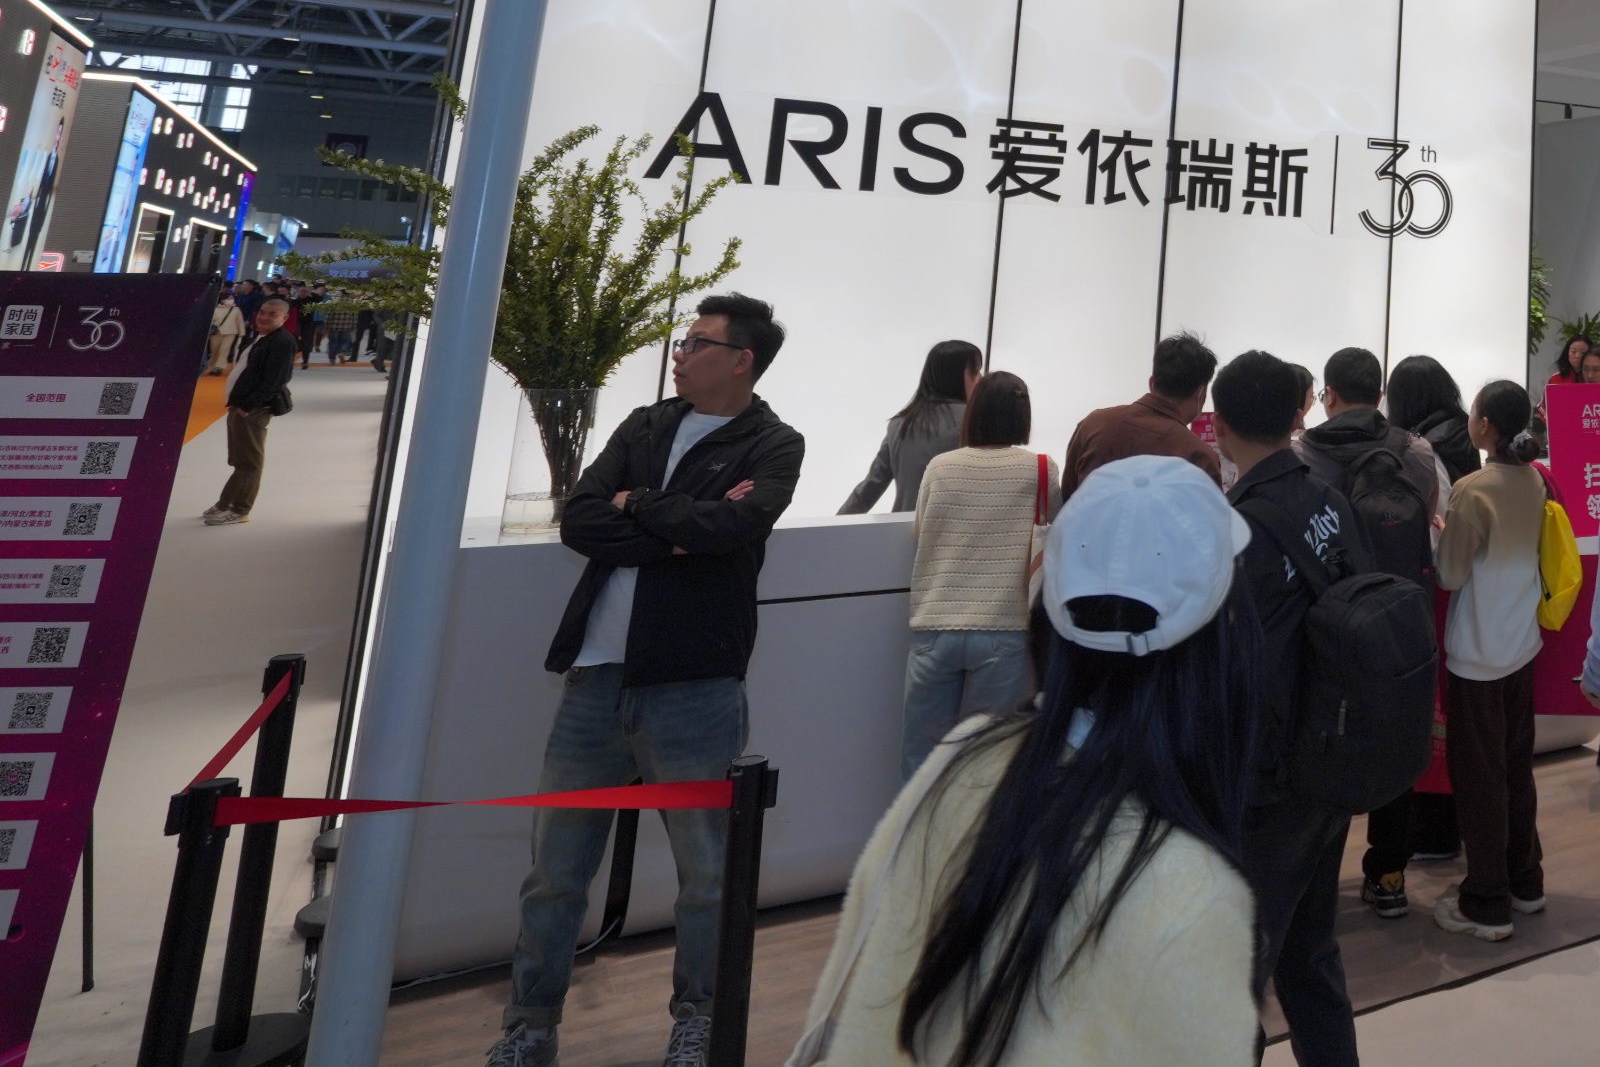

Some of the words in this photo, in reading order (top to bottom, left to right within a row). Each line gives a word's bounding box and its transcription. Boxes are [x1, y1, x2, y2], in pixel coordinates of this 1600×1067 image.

[643, 91, 967, 195] ARIS
[985, 118, 1309, 219] 爱依瑞斯
[8, 308, 38, 321] 时尚
[4, 323, 35, 336] 家居
[25, 393, 67, 403] 全国范围
